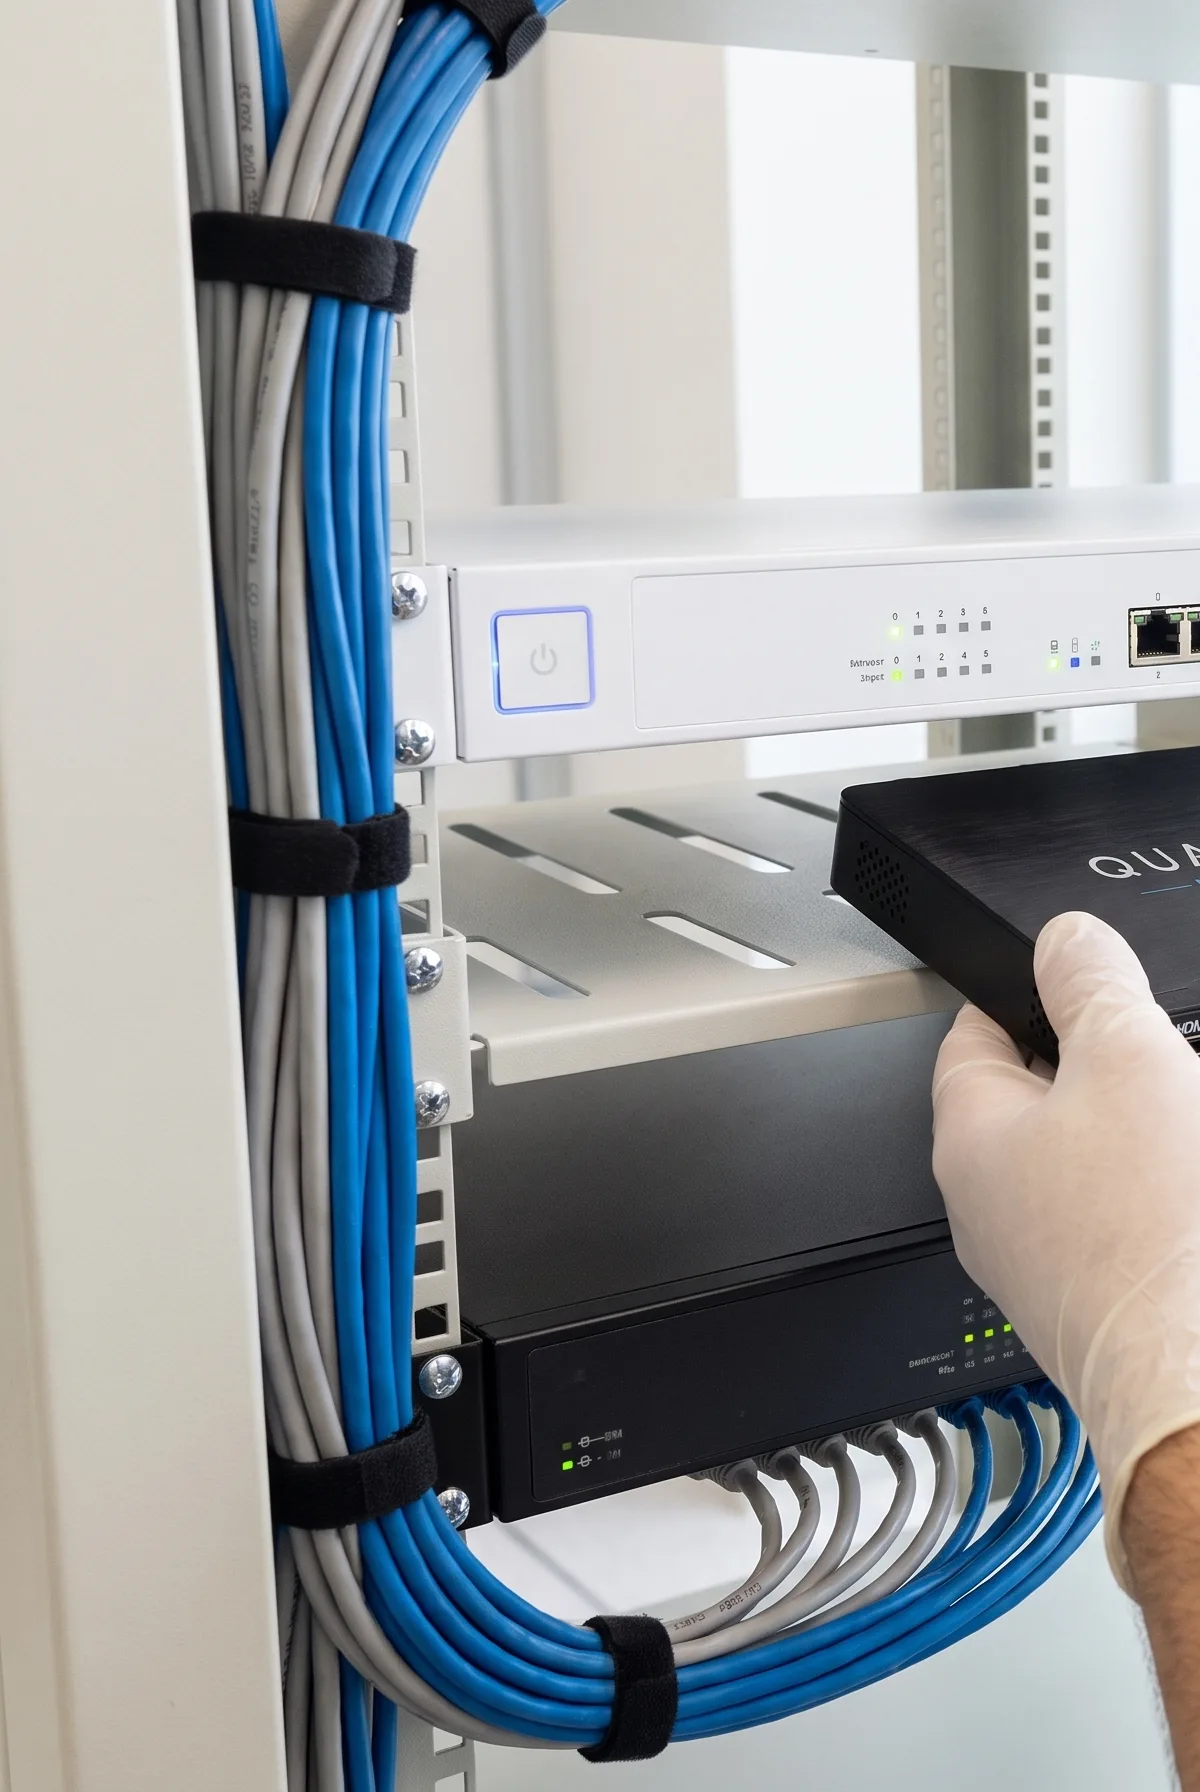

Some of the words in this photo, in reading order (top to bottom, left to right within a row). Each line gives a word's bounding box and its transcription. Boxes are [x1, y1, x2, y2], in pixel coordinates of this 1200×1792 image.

[892, 612, 898, 621] 0
[938, 609, 944, 618] 2
[893, 656, 900, 664] 0
[939, 653, 945, 661] 2
[961, 651, 967, 659] 4
[983, 649, 989, 658] 5
